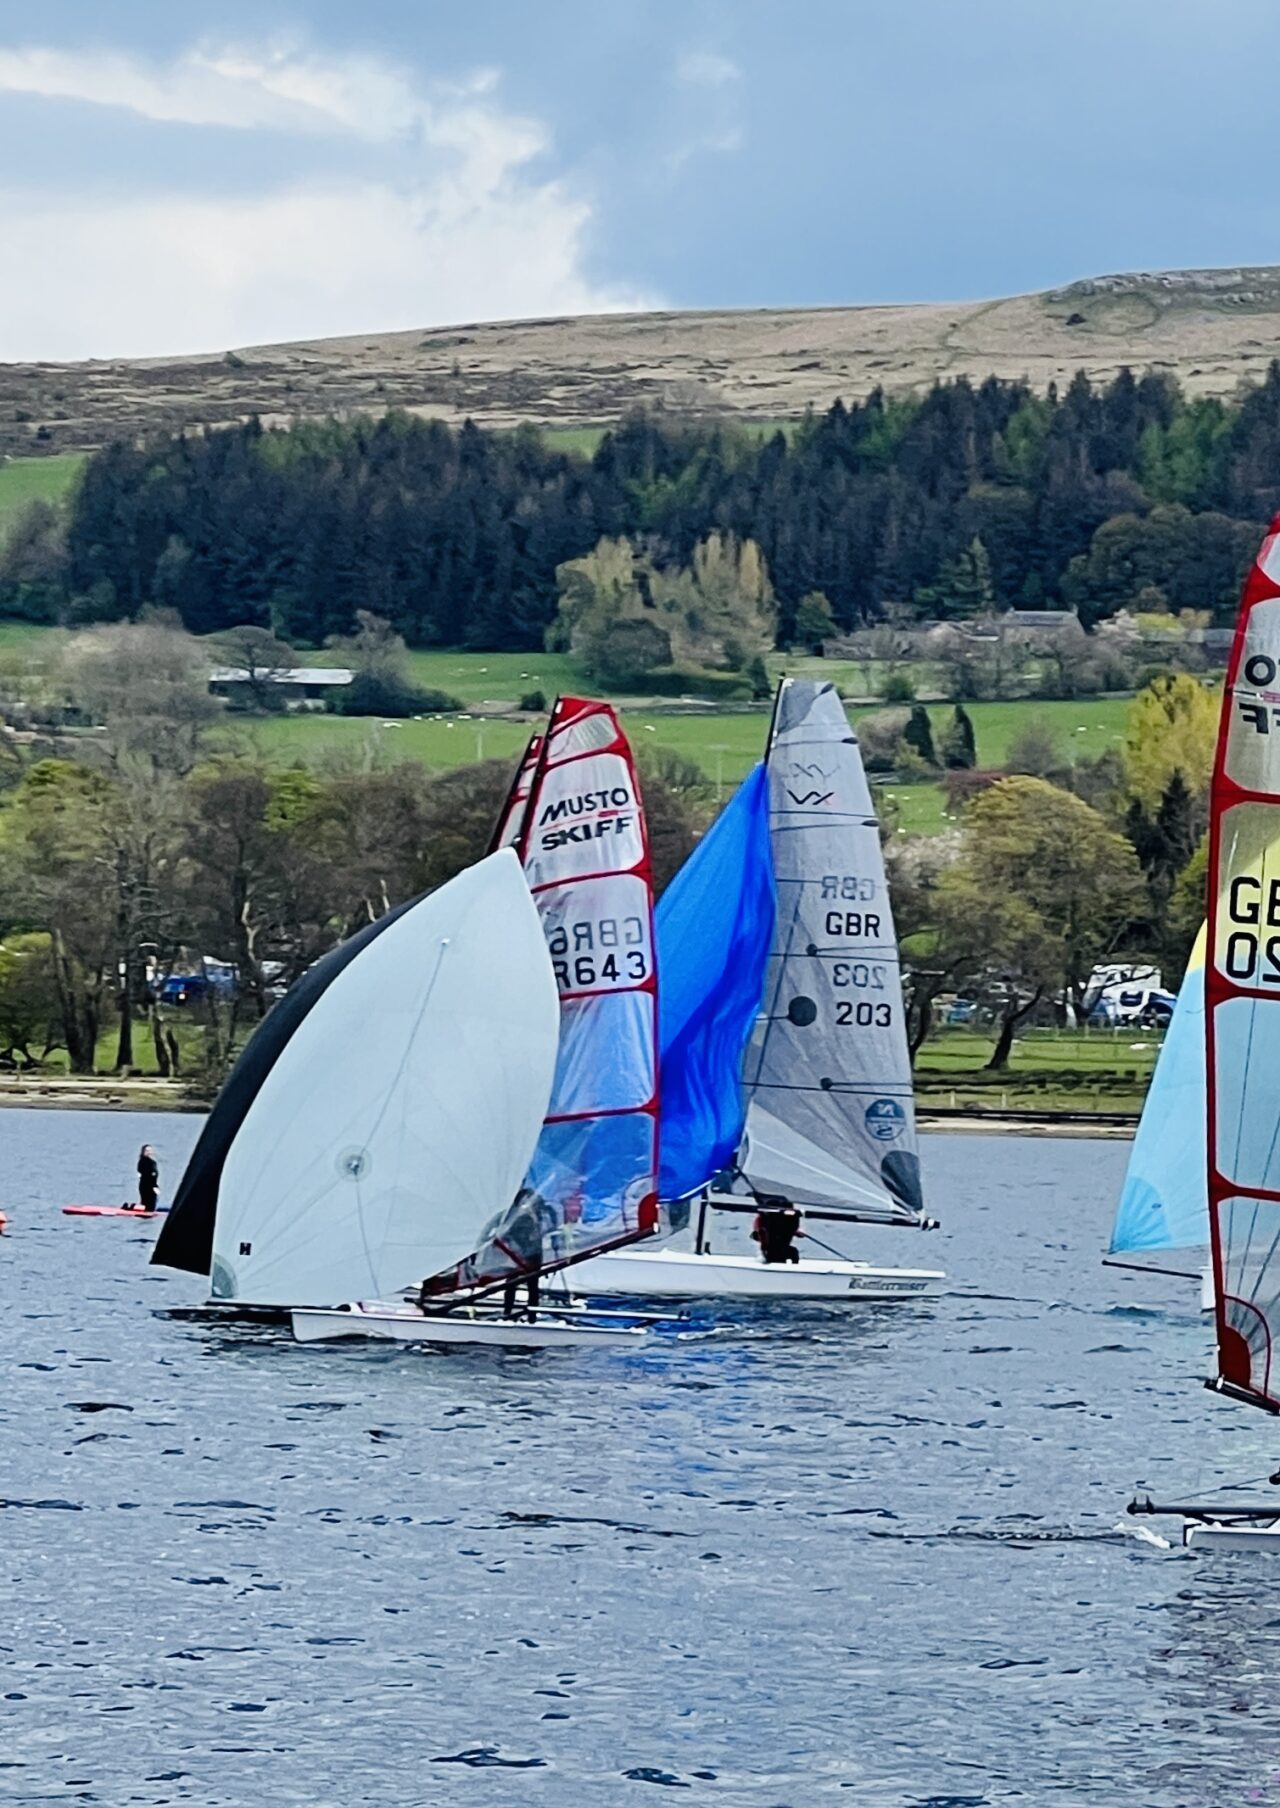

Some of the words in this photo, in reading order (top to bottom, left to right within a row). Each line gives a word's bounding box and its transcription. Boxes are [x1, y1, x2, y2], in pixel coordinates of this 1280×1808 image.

[539, 787, 629, 827] MUSTO
[541, 816, 634, 851] SKIFF
[825, 911, 880, 938] GBR
[552, 951, 647, 989] R643
[836, 1001, 891, 1028] 203
